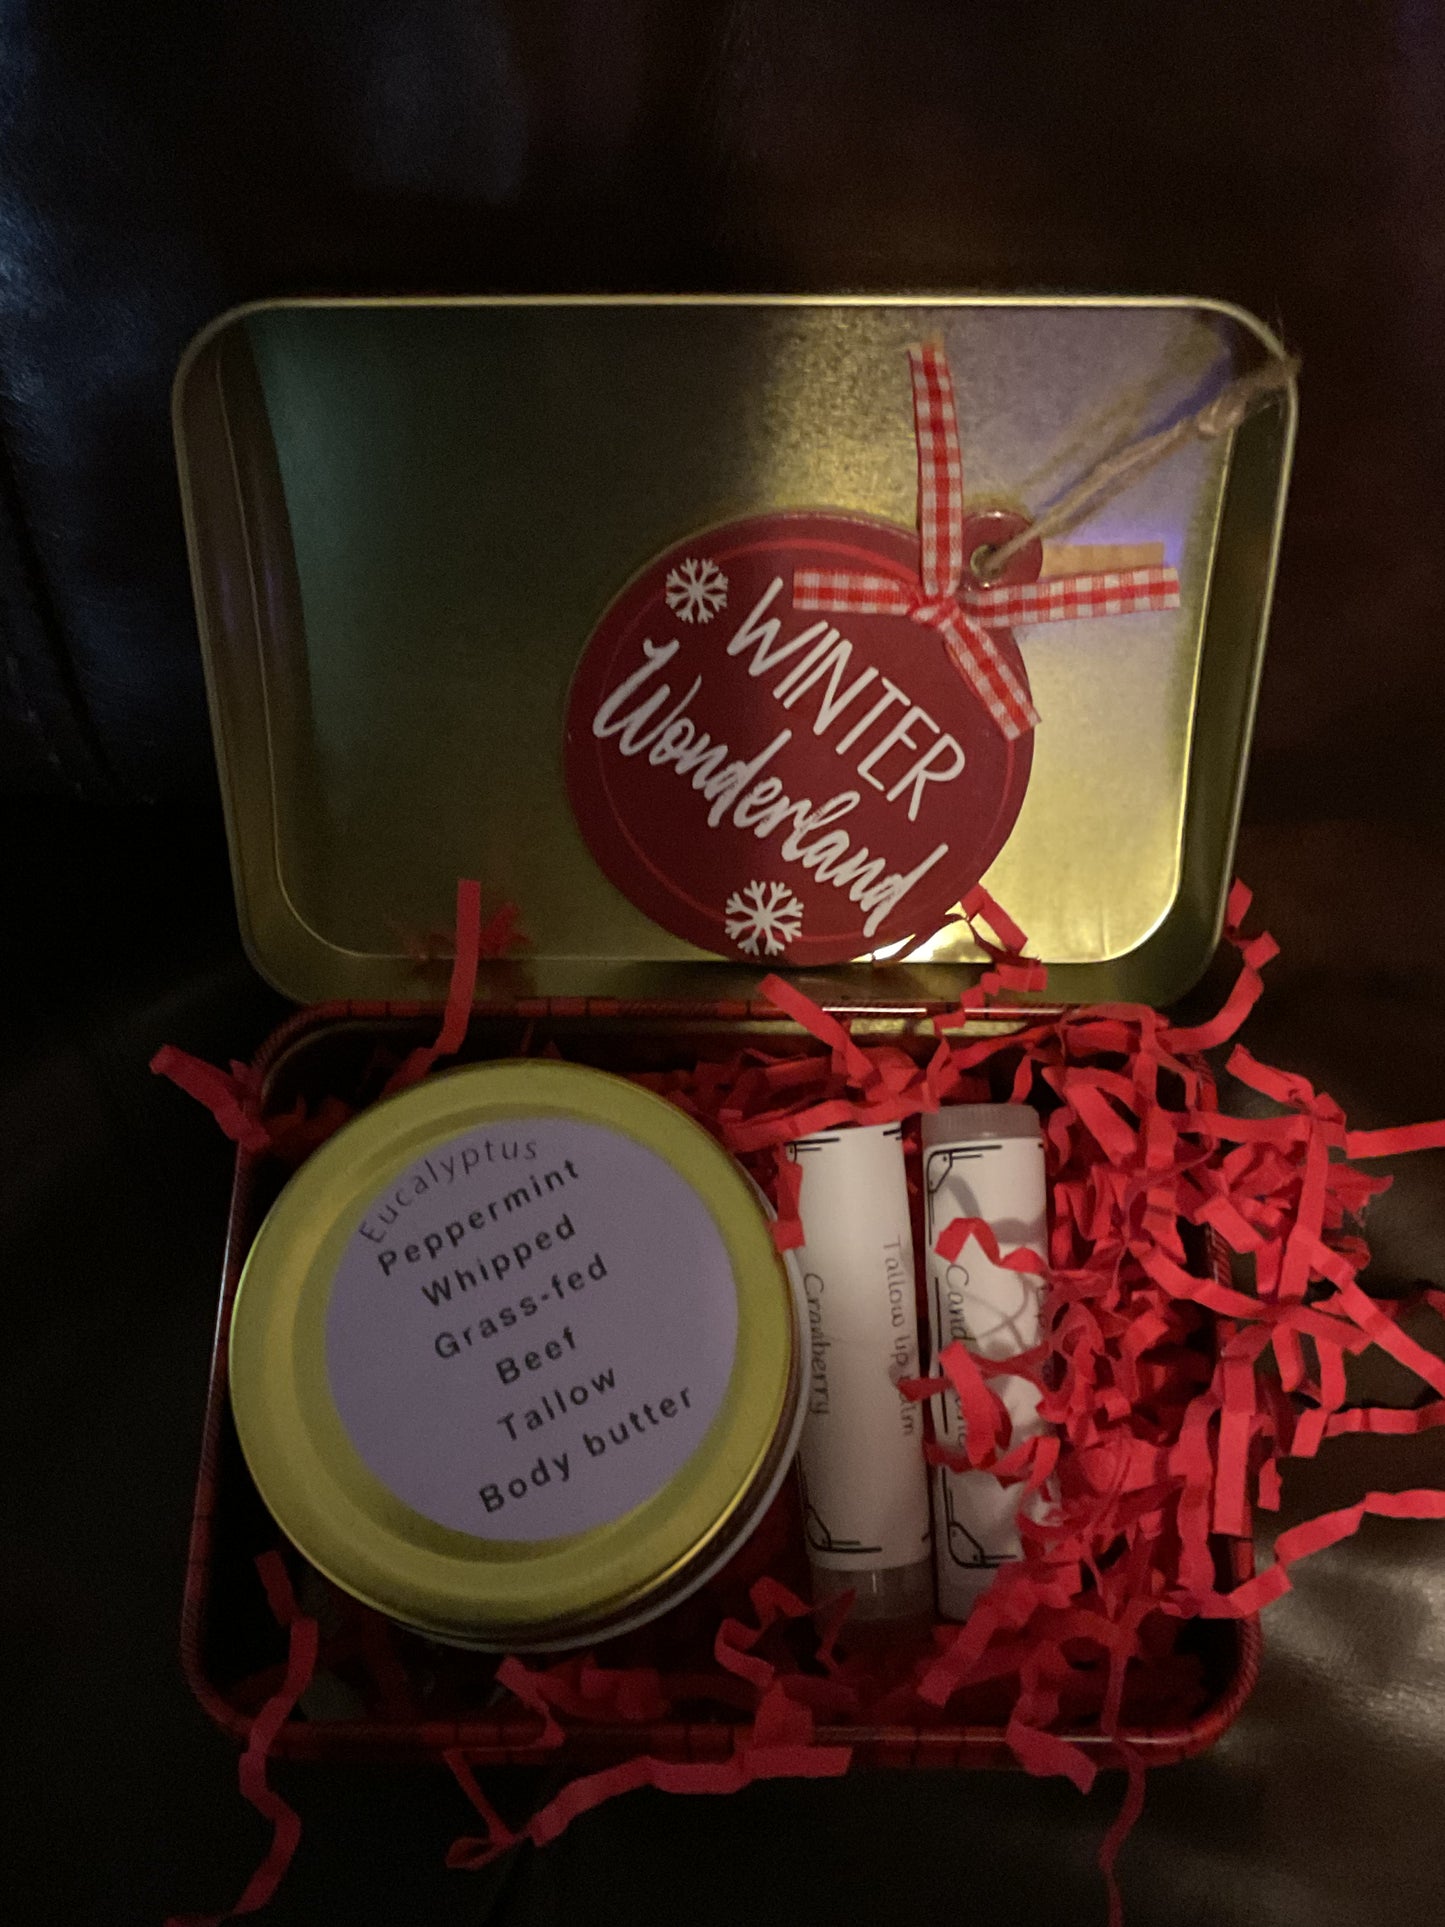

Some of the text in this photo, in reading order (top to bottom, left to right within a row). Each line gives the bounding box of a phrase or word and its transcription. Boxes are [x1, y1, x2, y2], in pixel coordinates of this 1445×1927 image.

[726, 577, 966, 822] WINTER
[592, 638, 949, 938] Wonderland
[359, 1138, 538, 1244] Eucalyptus
[377, 1159, 580, 1276] Peppermint
[421, 1213, 576, 1306] Whipped
[434, 1253, 608, 1359] Grass-fed
[883, 1235, 905, 1328] Tallow
[946, 1264, 977, 1342] Cand
[496, 1326, 577, 1385] Beef
[497, 1368, 616, 1442] Tallow
[479, 1387, 693, 1513] Body butter
